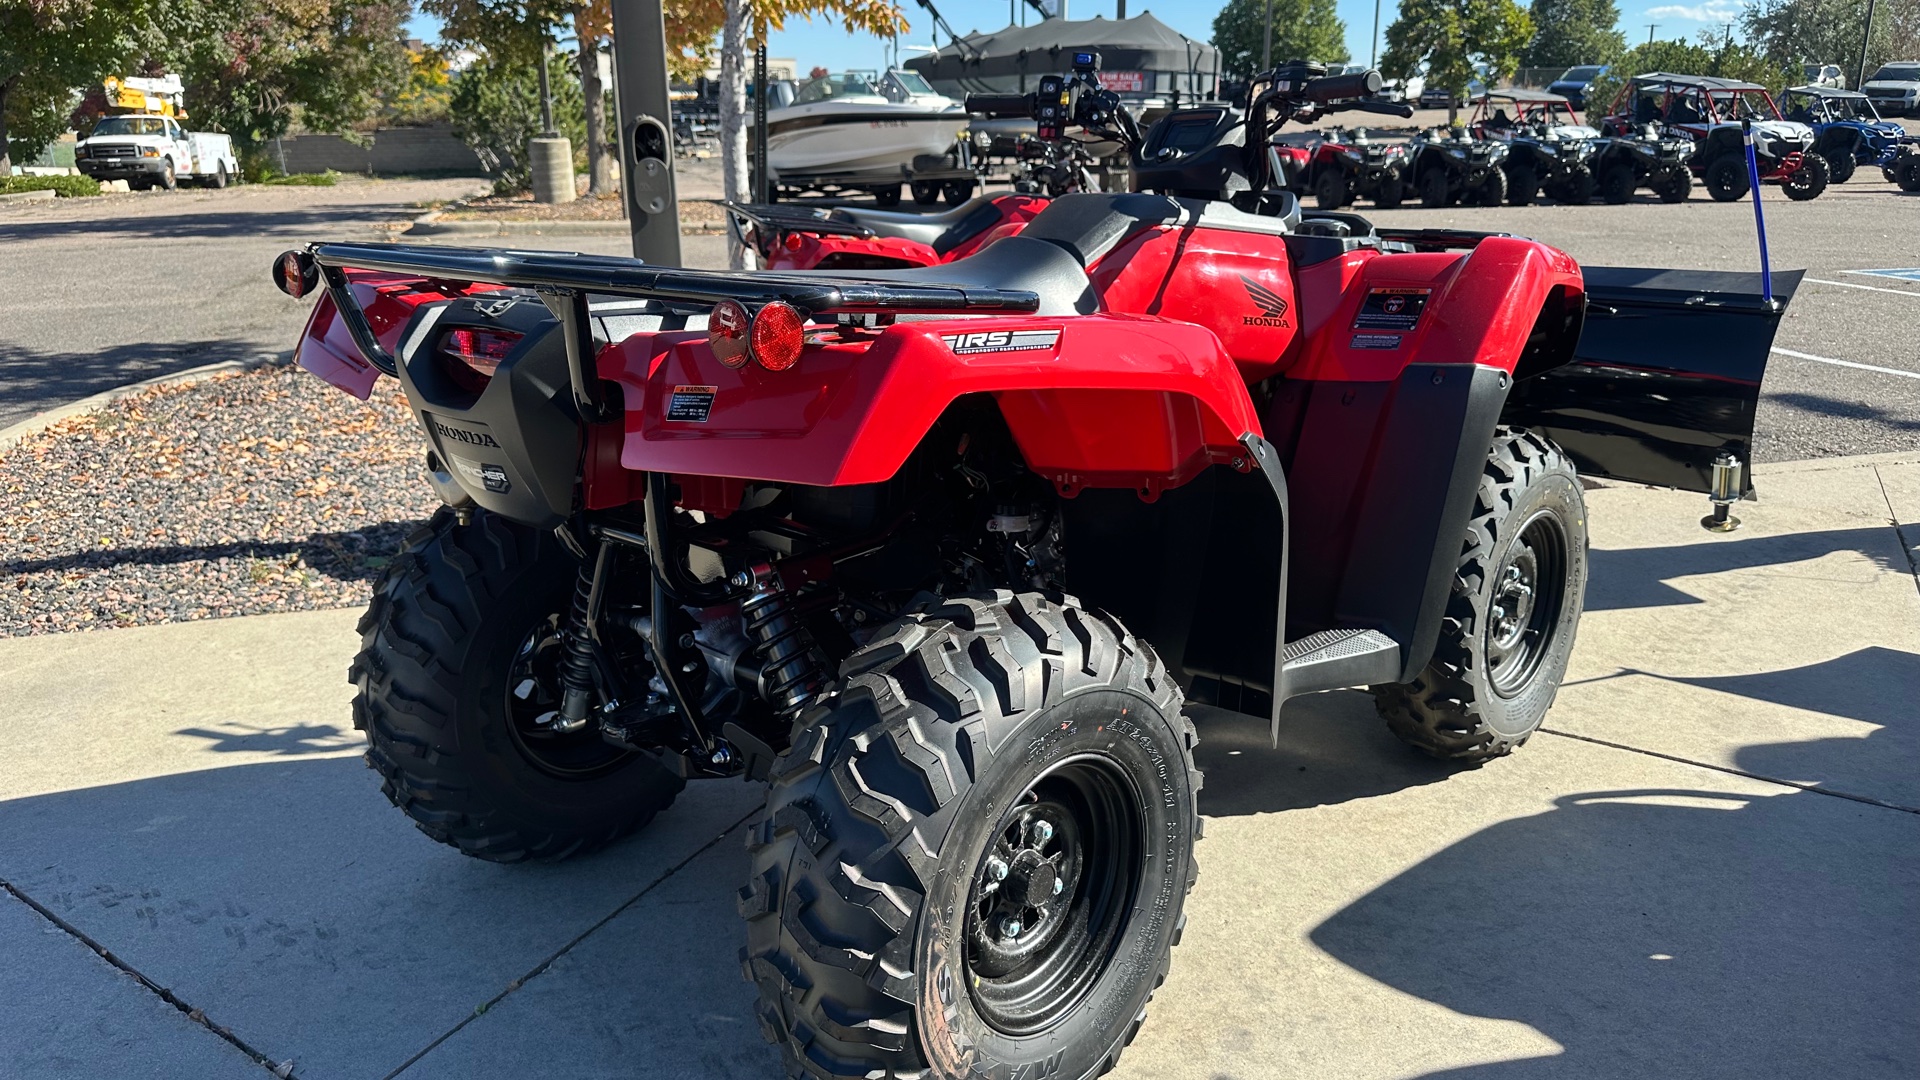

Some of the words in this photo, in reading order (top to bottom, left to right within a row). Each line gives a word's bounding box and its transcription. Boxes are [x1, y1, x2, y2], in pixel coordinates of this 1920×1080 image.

[1101, 72, 1118, 81] FOR
[1119, 72, 1139, 81] SALE
[1657, 125, 1695, 141] HONDA
[1388, 304, 1398, 312] 16
[1243, 316, 1290, 328] HONDA
[956, 332, 1009, 347] IRS
[435, 421, 501, 449] HONDA
[455, 461, 507, 482] RANCHER
